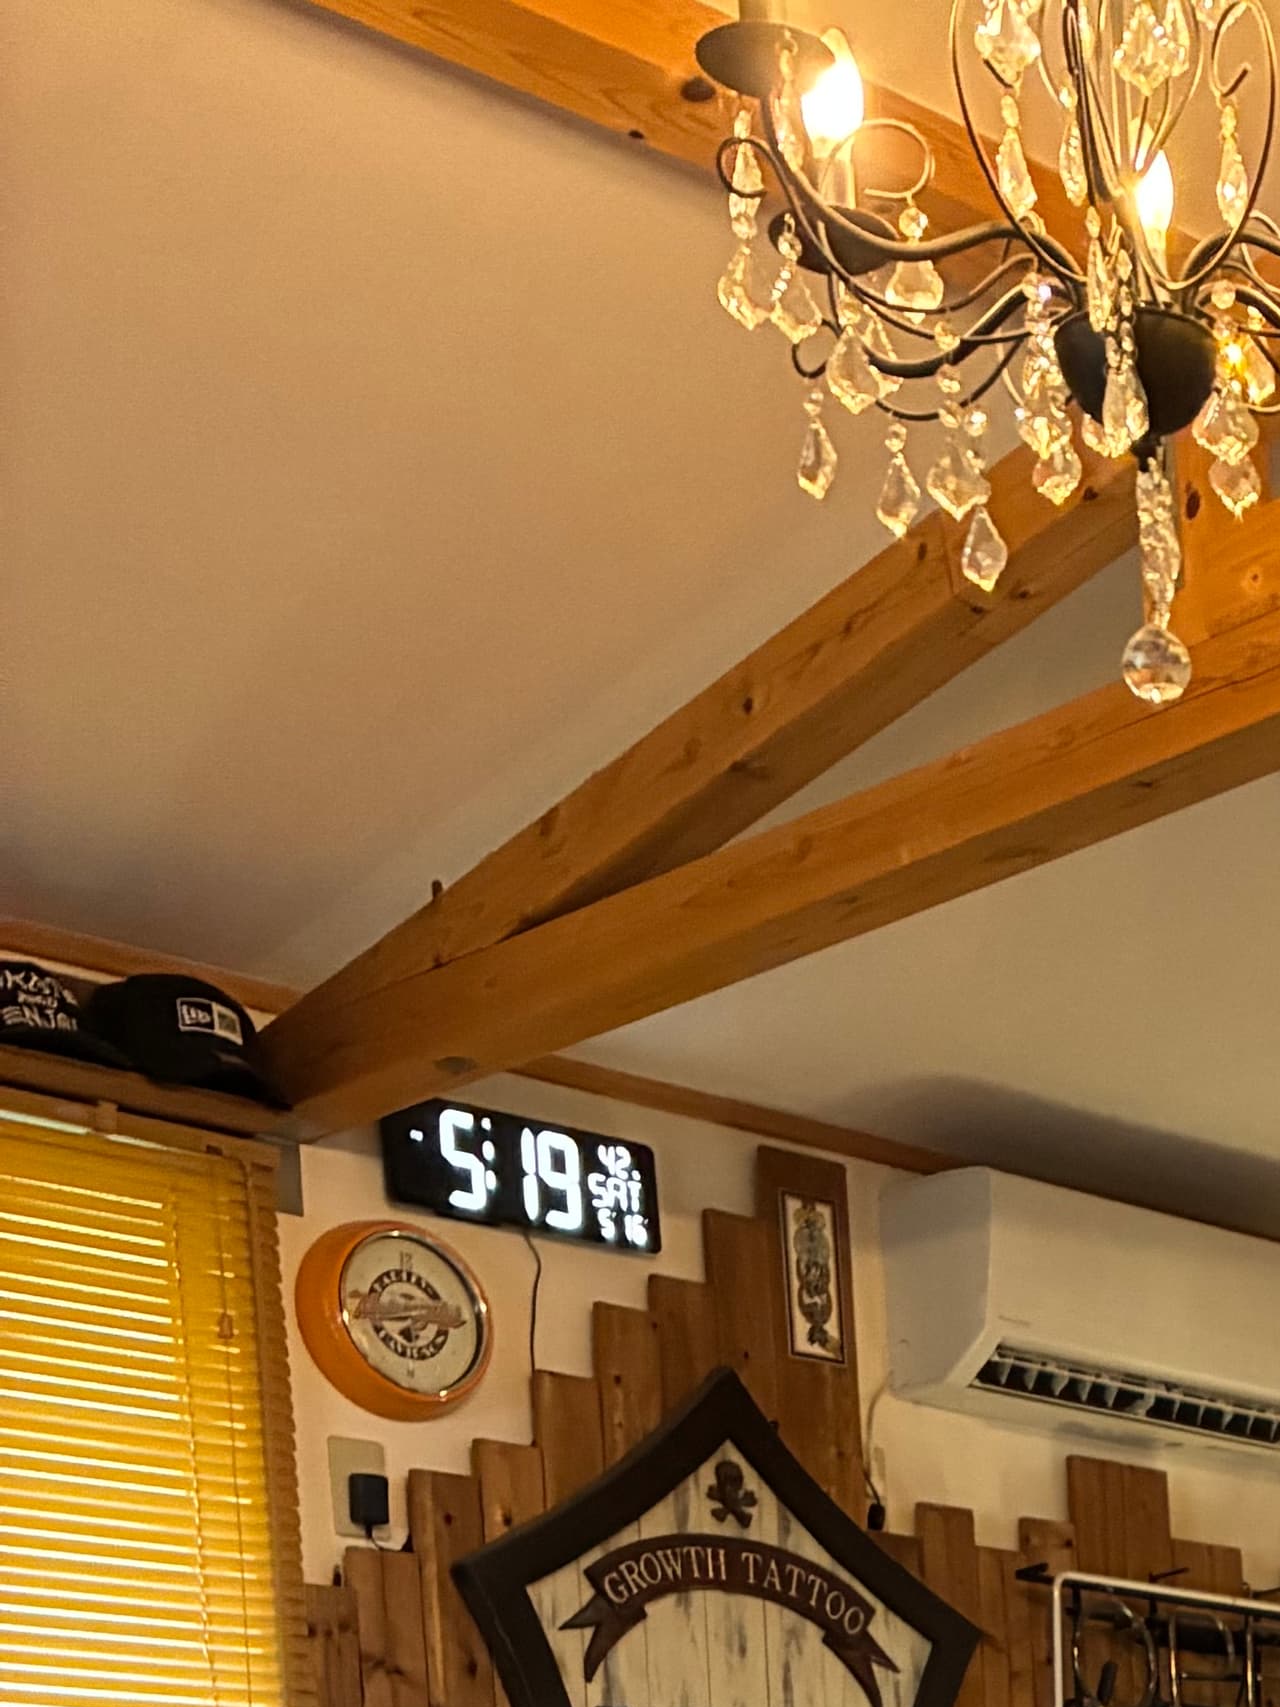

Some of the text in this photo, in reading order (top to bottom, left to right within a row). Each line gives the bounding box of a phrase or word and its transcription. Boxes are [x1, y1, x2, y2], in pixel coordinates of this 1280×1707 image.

[588, 1172, 642, 1213] SAT
[603, 1545, 866, 1636] GROWTH TATTOO
